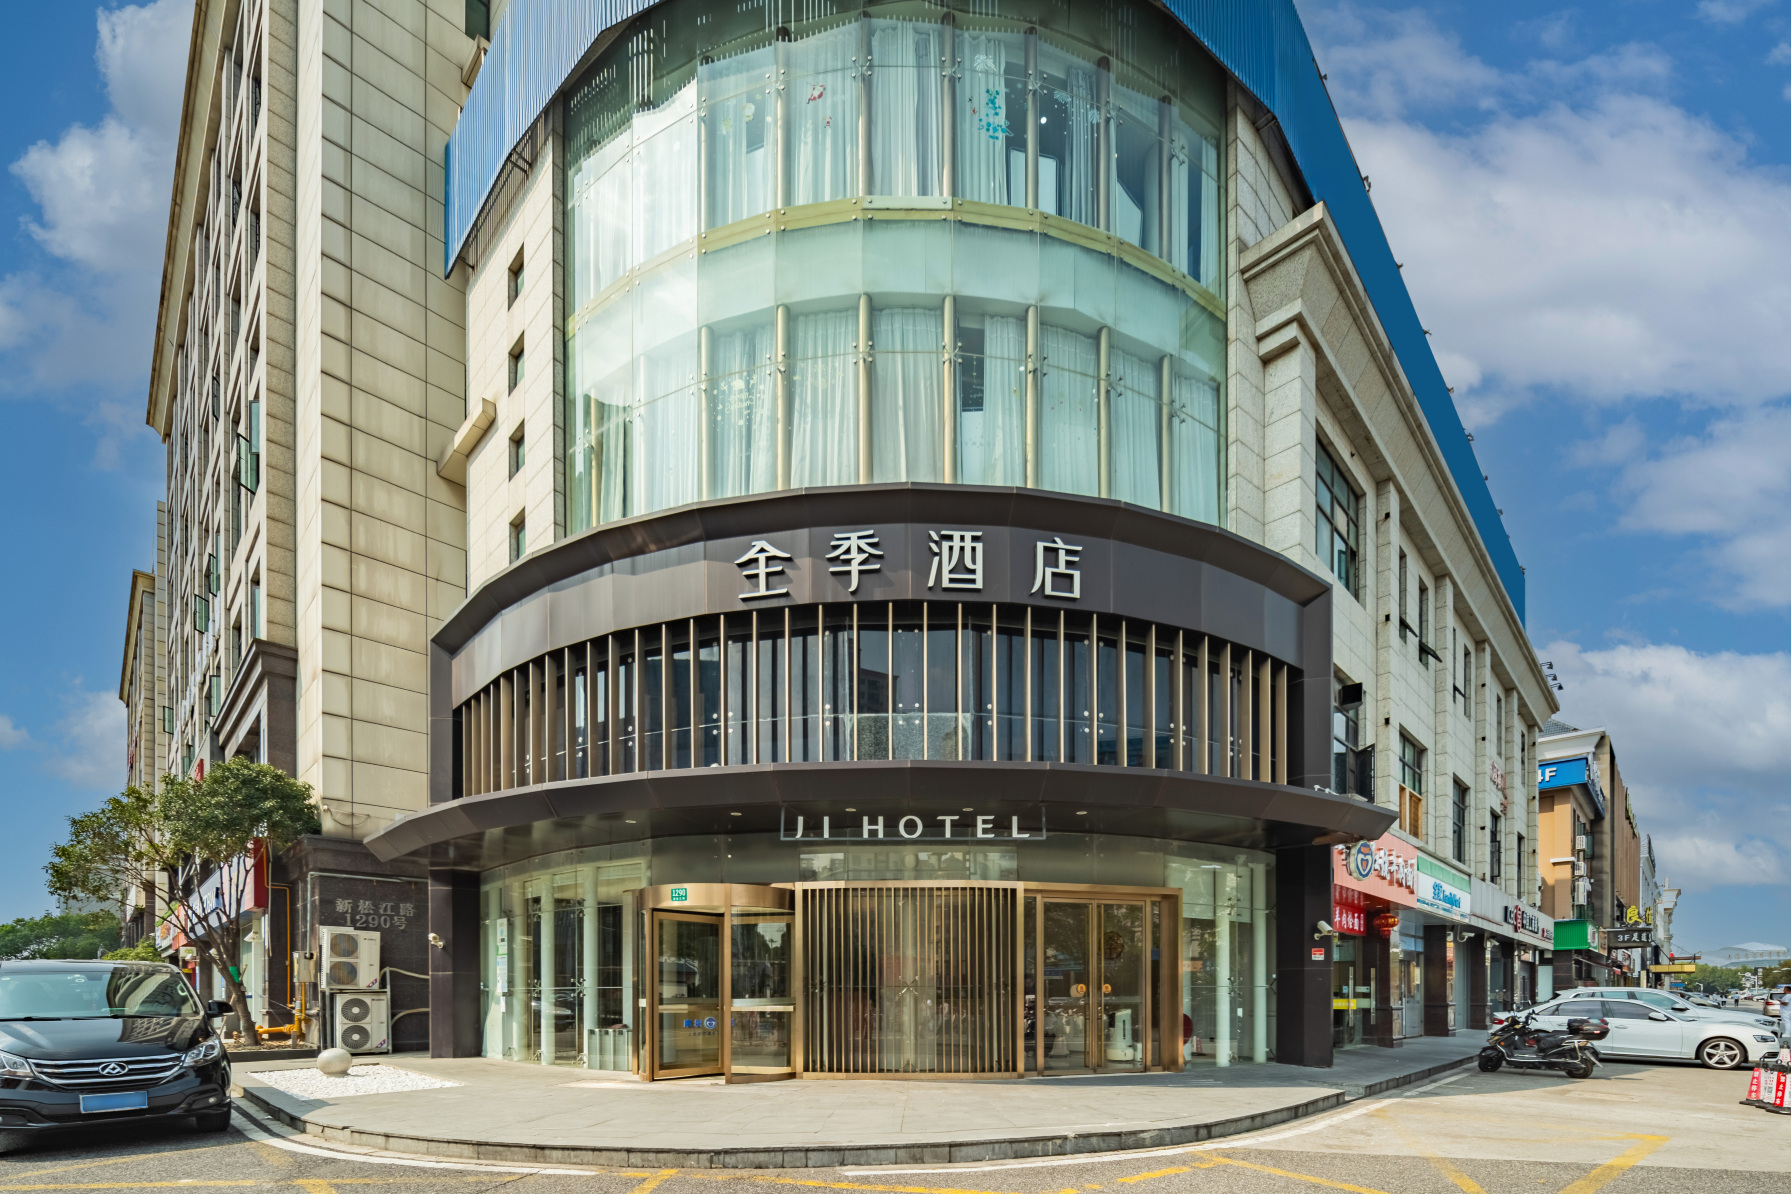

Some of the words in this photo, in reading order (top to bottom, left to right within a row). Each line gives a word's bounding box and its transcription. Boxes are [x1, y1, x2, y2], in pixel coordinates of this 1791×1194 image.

[734, 529, 1083, 600] 全季酒店
[795, 815, 830, 839] JI
[862, 815, 1030, 839] HOTEL
[672, 888, 686, 897] 1290
[336, 898, 416, 917] 新松江路
[344, 914, 408, 930] 1290号
